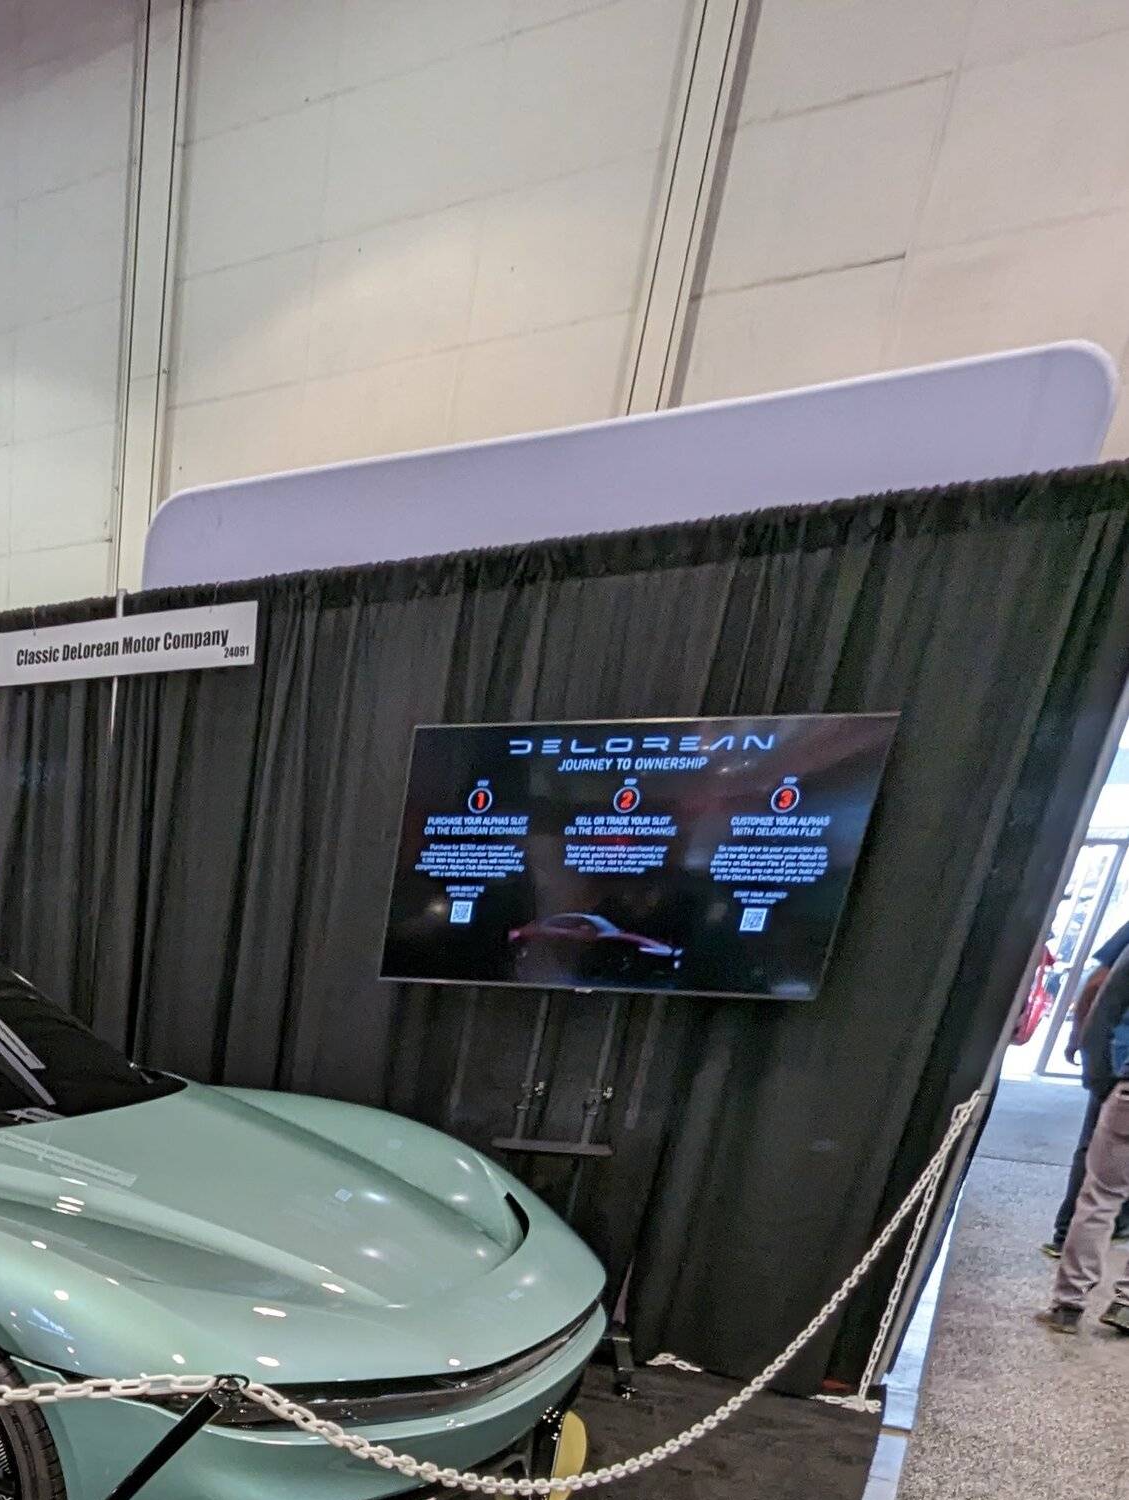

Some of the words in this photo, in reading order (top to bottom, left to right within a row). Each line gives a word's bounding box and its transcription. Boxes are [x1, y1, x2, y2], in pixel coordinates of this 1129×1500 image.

[16, 646, 59, 667] Classic
[62, 639, 119, 661] DeLorean
[122, 635, 159, 655] Motor
[163, 629, 229, 651] Company
[224, 645, 250, 659] 24091
[509, 735, 775, 755] DELOREAN
[558, 758, 613, 772] JOURNEY
[617, 758, 631, 770] TO
[634, 757, 708, 770] OWNERSHIP
[575, 816, 592, 826] SELL
[594, 816, 605, 826] OR
[606, 816, 630, 826] TRADE
[631, 816, 650, 826] YOUR
[652, 816, 672, 826] SLOT
[564, 826, 577, 836] ON
[578, 826, 592, 836] THE
[594, 826, 633, 836] DELOREAN
[635, 826, 677, 836] EXCHANGE
[732, 827, 754, 836] WITH
[755, 827, 799, 836] DELOREAN
[800, 827, 822, 836] FLEX
